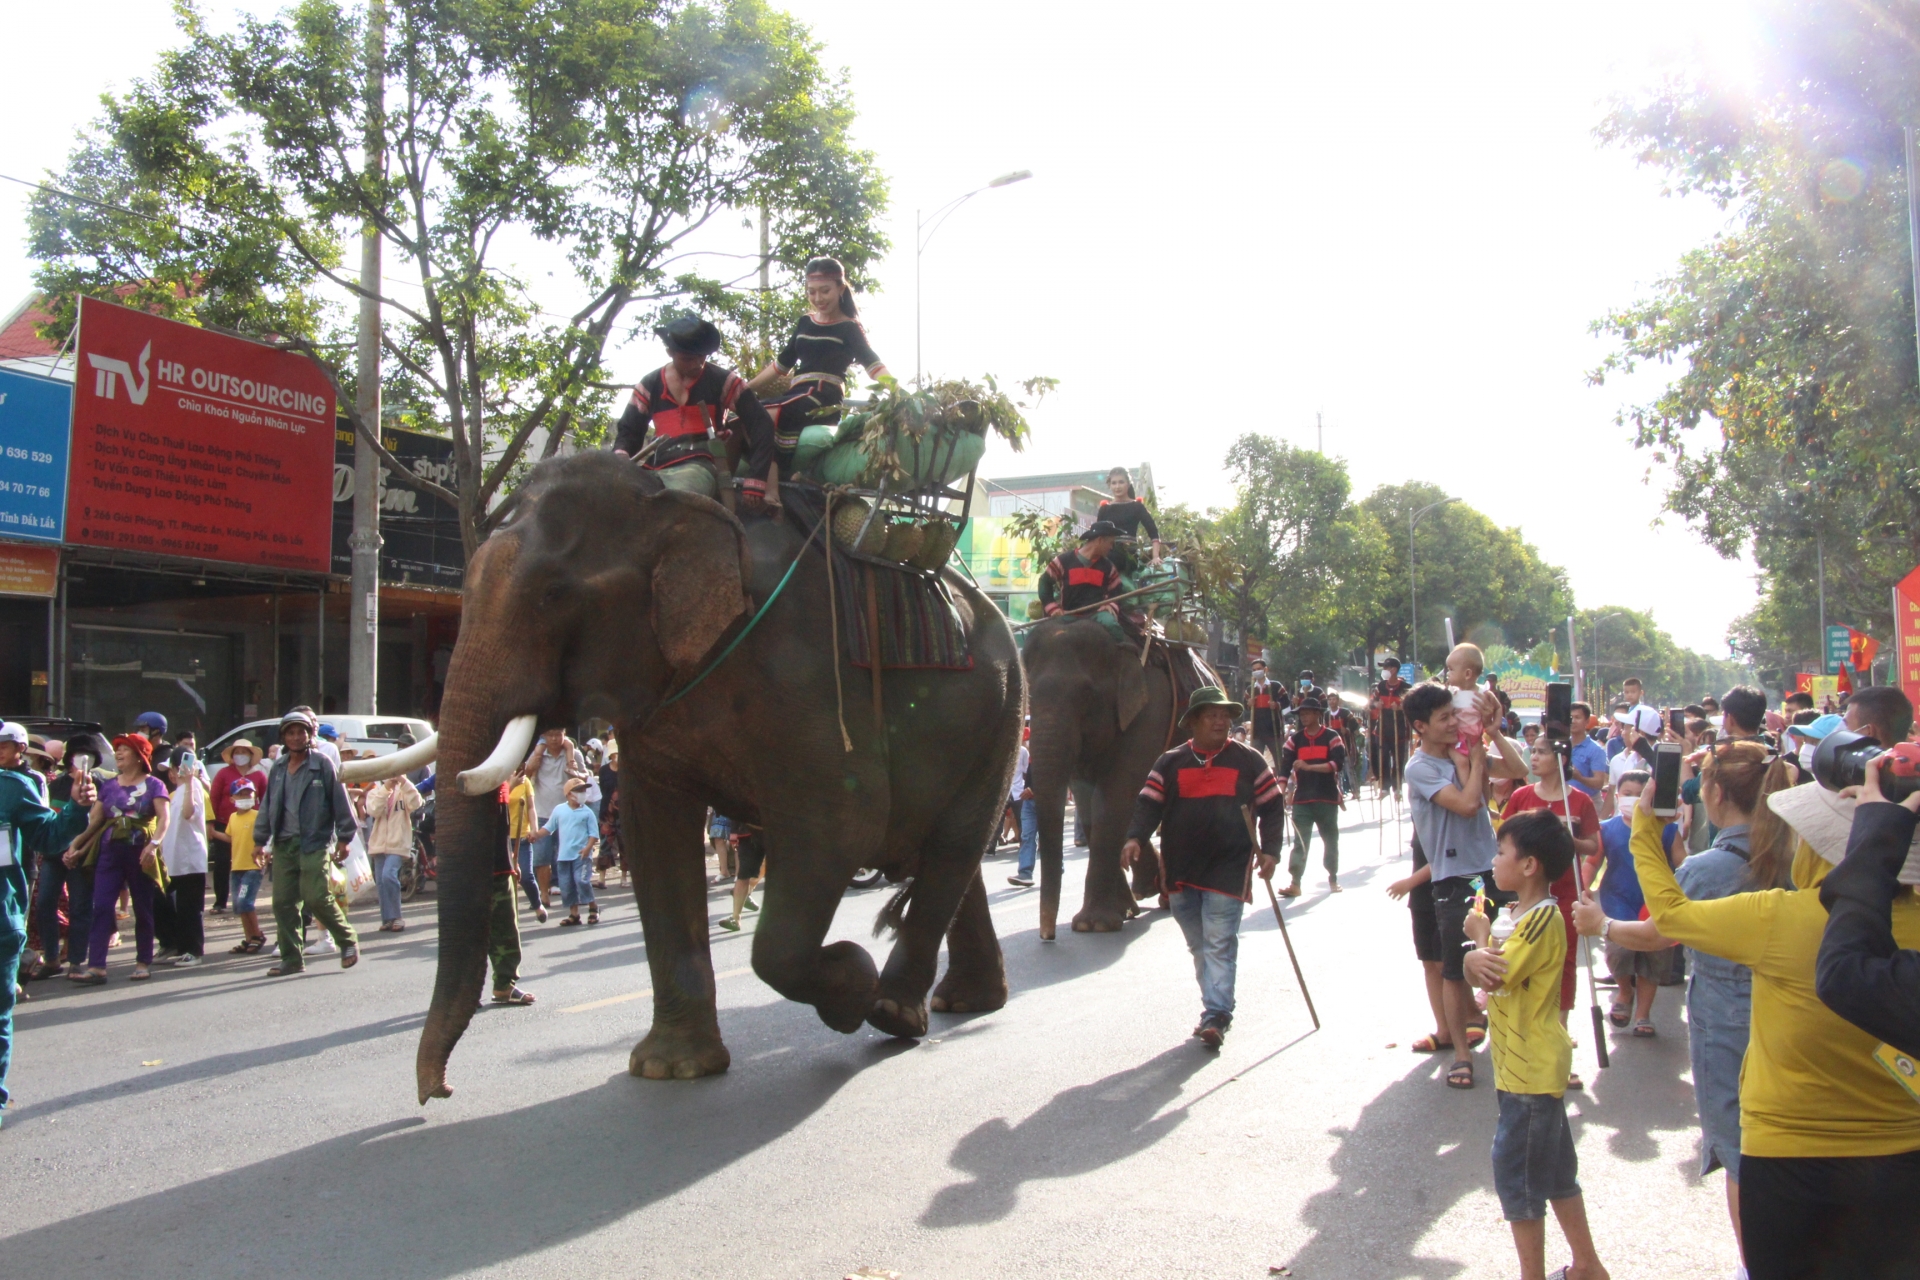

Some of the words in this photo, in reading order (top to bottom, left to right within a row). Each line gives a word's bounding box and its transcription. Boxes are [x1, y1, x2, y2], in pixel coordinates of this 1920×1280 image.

[158, 359, 185, 385] HR
[191, 368, 327, 416] OUTSOURCING
[178, 397, 201, 412] Chìa
[204, 403, 230, 418] Khoá
[264, 416, 288, 430] Nhân
[291, 422, 306, 435] Lực
[6, 447, 28, 460] 636
[31, 451, 53, 464] 529
[95, 441, 119, 456] Dịch
[122, 446, 135, 460] Vụ
[138, 449, 165, 466] Cung
[168, 452, 187, 470] Ứng
[190, 459, 214, 471] Nhân
[217, 463, 233, 476] Lực
[236, 466, 270, 481] Chuyên
[273, 472, 291, 485] Môn
[96, 423, 119, 439] Dịch
[123, 429, 136, 443] Vụ
[139, 432, 159, 445] Cho
[162, 436, 185, 450] Thuê
[188, 442, 205, 453] Lao
[208, 445, 232, 460] Động
[235, 449, 252, 462] Phổ
[255, 454, 281, 469] Thông
[12, 482, 24, 493] 70
[26, 484, 37, 495] 77
[39, 486, 50, 498] 66
[93, 459, 106, 471] Tư
[109, 461, 129, 474] Vấn
[132, 465, 152, 478] Giới
[155, 470, 181, 485] Thiệu
[184, 474, 204, 488] Việc
[207, 478, 227, 490] Làm
[93, 476, 122, 491] Tuyển
[125, 482, 151, 498] Dụng
[154, 486, 172, 498] Lao
[175, 489, 201, 505] Động
[203, 493, 221, 505] Phổ
[224, 497, 252, 513] Thông
[0, 510, 19, 524] Tỉnh
[21, 512, 38, 527] Đắk
[40, 515, 55, 529] Lắk
[113, 512, 132, 523] Giải
[181, 521, 208, 533] Phước
